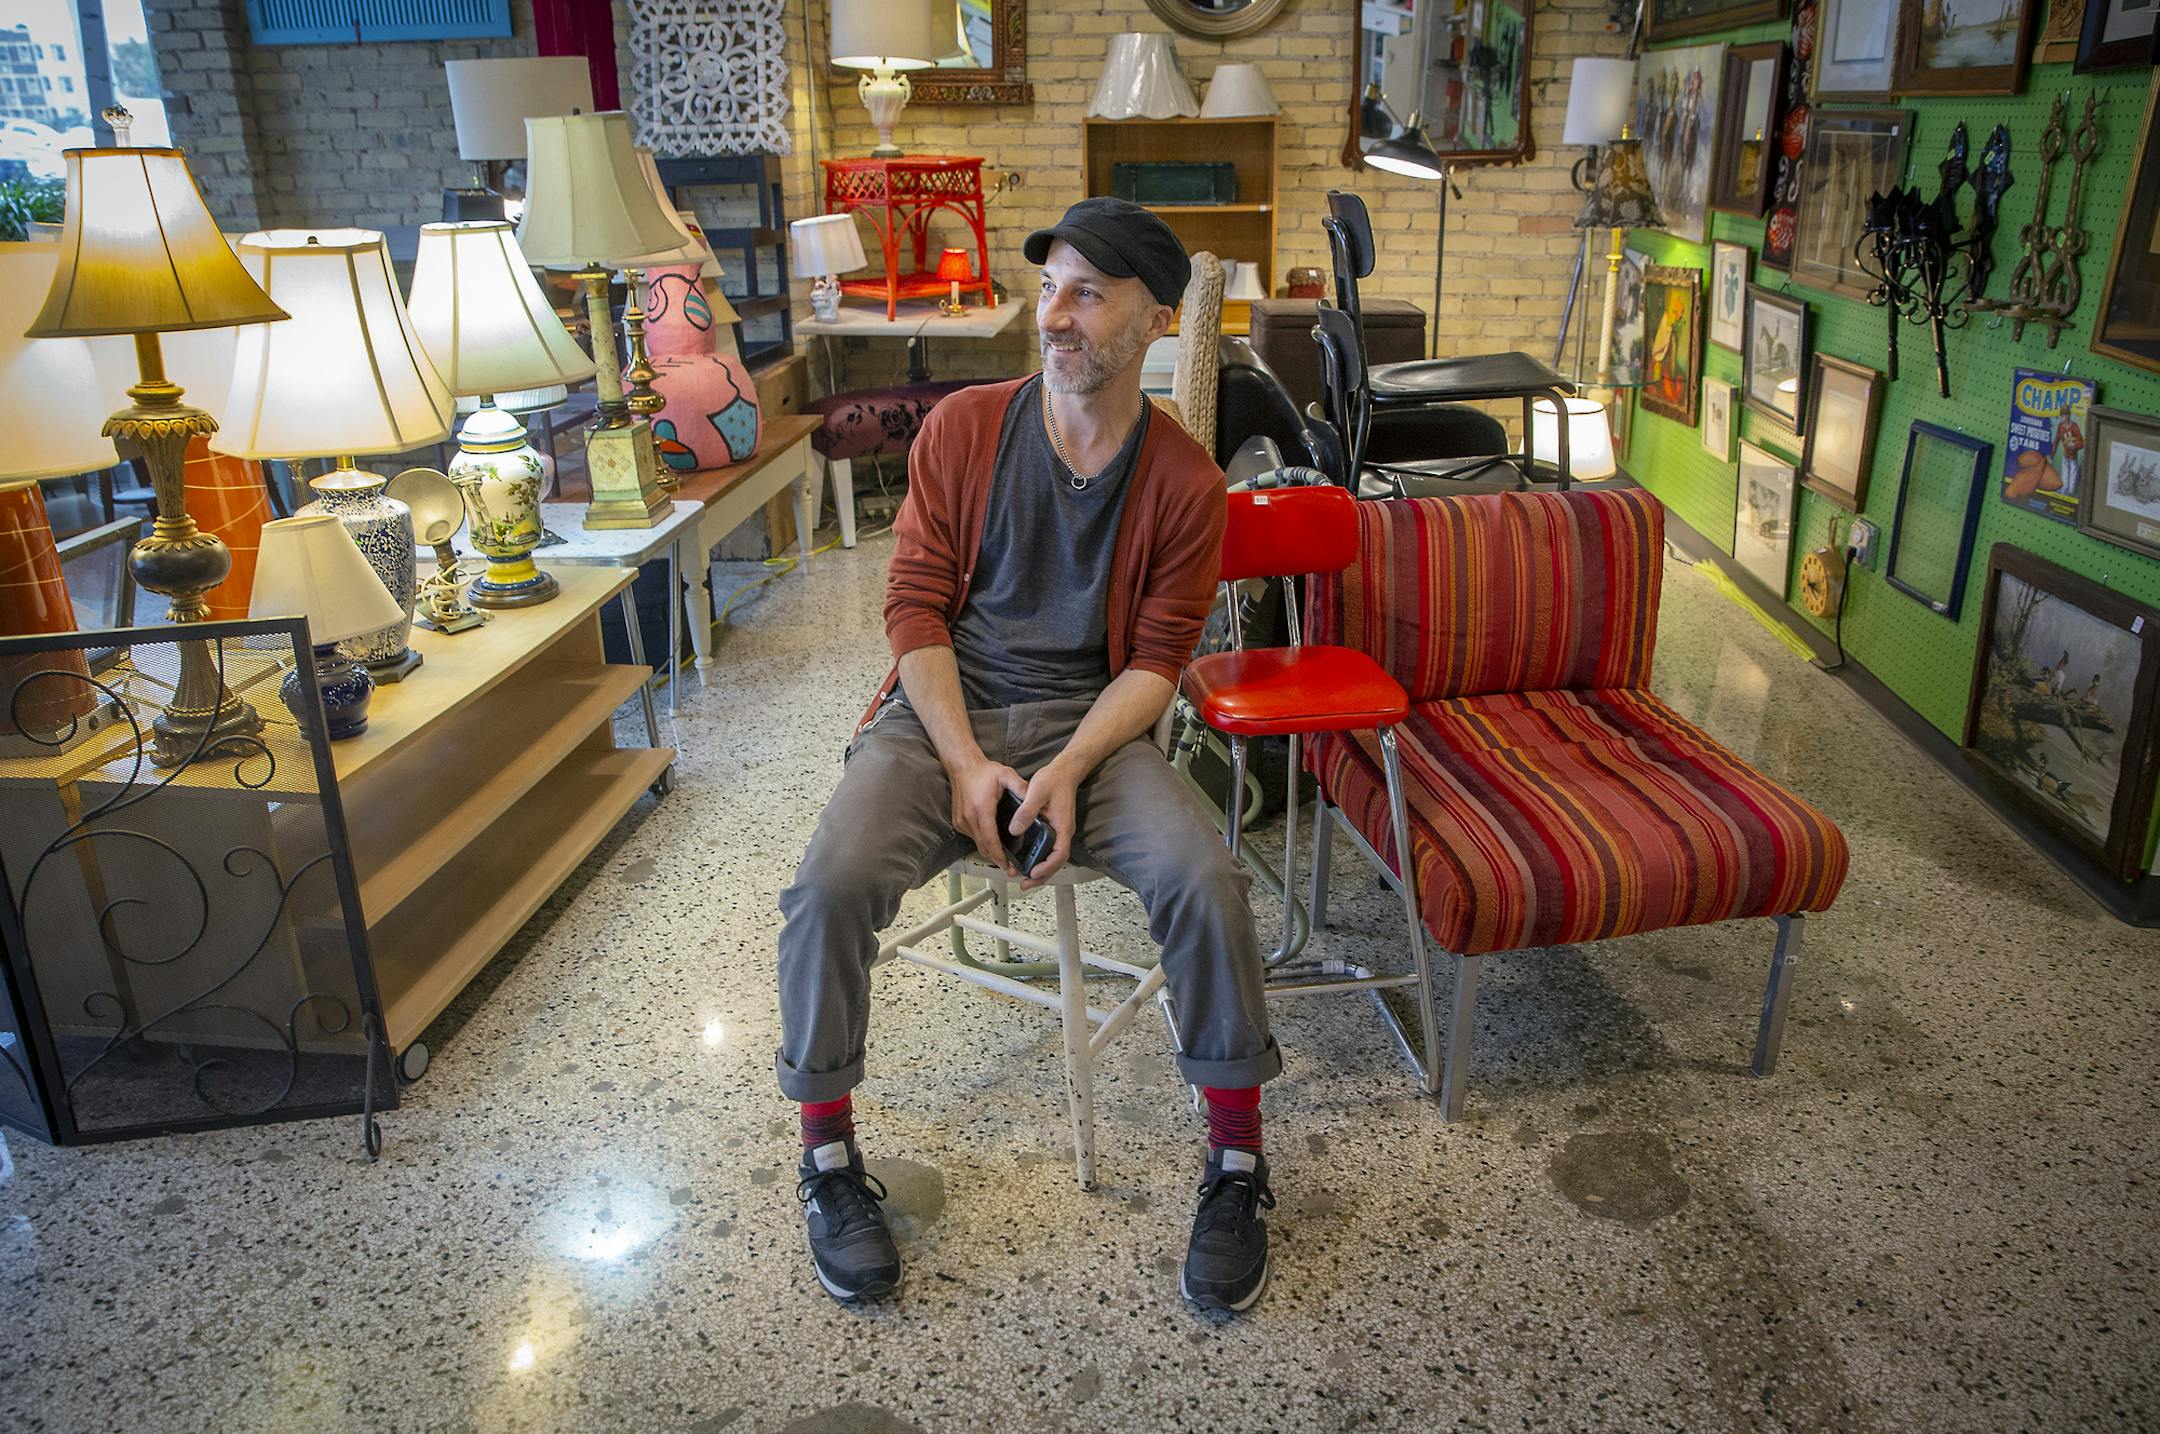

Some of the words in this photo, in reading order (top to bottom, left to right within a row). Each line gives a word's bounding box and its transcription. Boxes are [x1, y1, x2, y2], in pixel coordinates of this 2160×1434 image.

[2022, 384, 2081, 411] CHAMP
[2011, 422, 2026, 436] SWEET
[2018, 437, 2040, 450] YAMS
